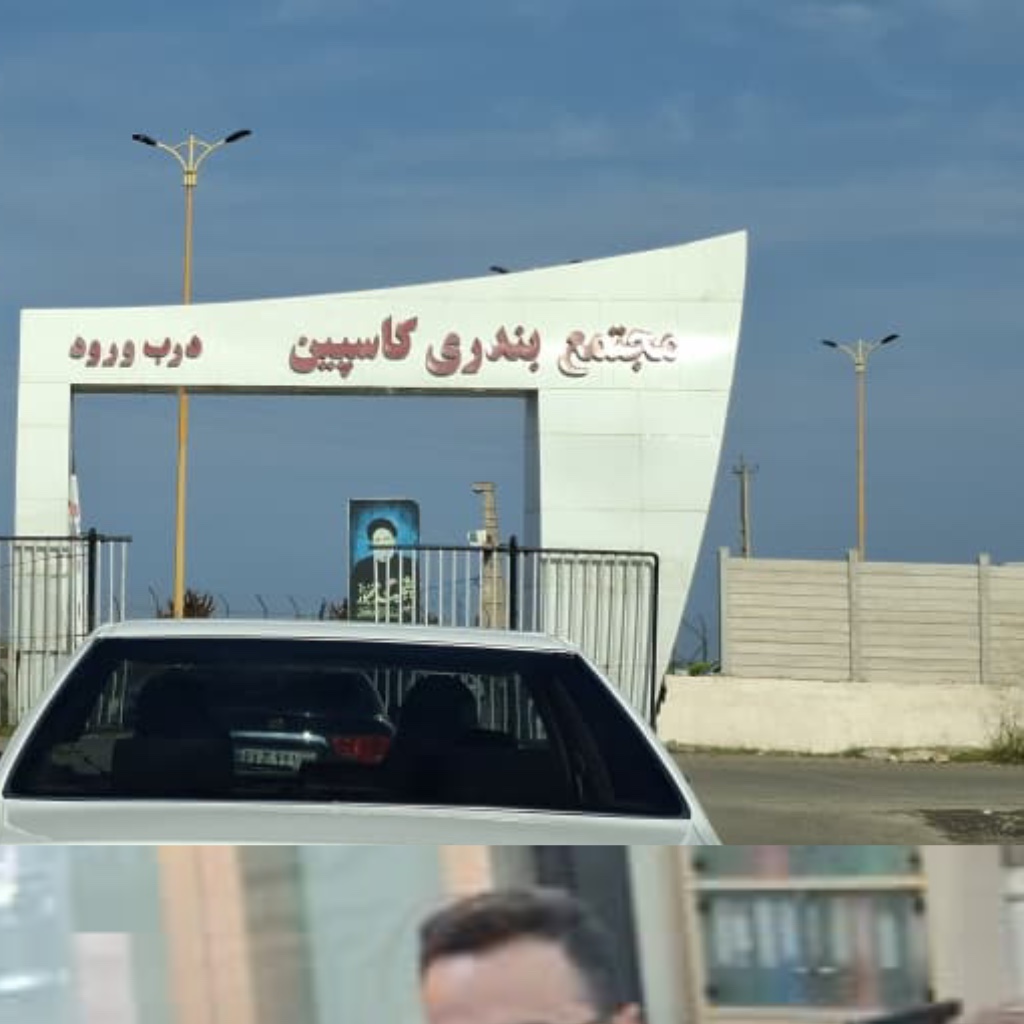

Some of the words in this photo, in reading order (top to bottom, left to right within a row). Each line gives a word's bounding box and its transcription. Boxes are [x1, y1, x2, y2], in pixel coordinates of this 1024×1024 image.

[69, 336, 136, 368] ورود
[142, 334, 204, 368] درب
[288, 314, 418, 379] کاسپین
[425, 325, 542, 376] بندری
[558, 325, 679, 378] مجتمع
